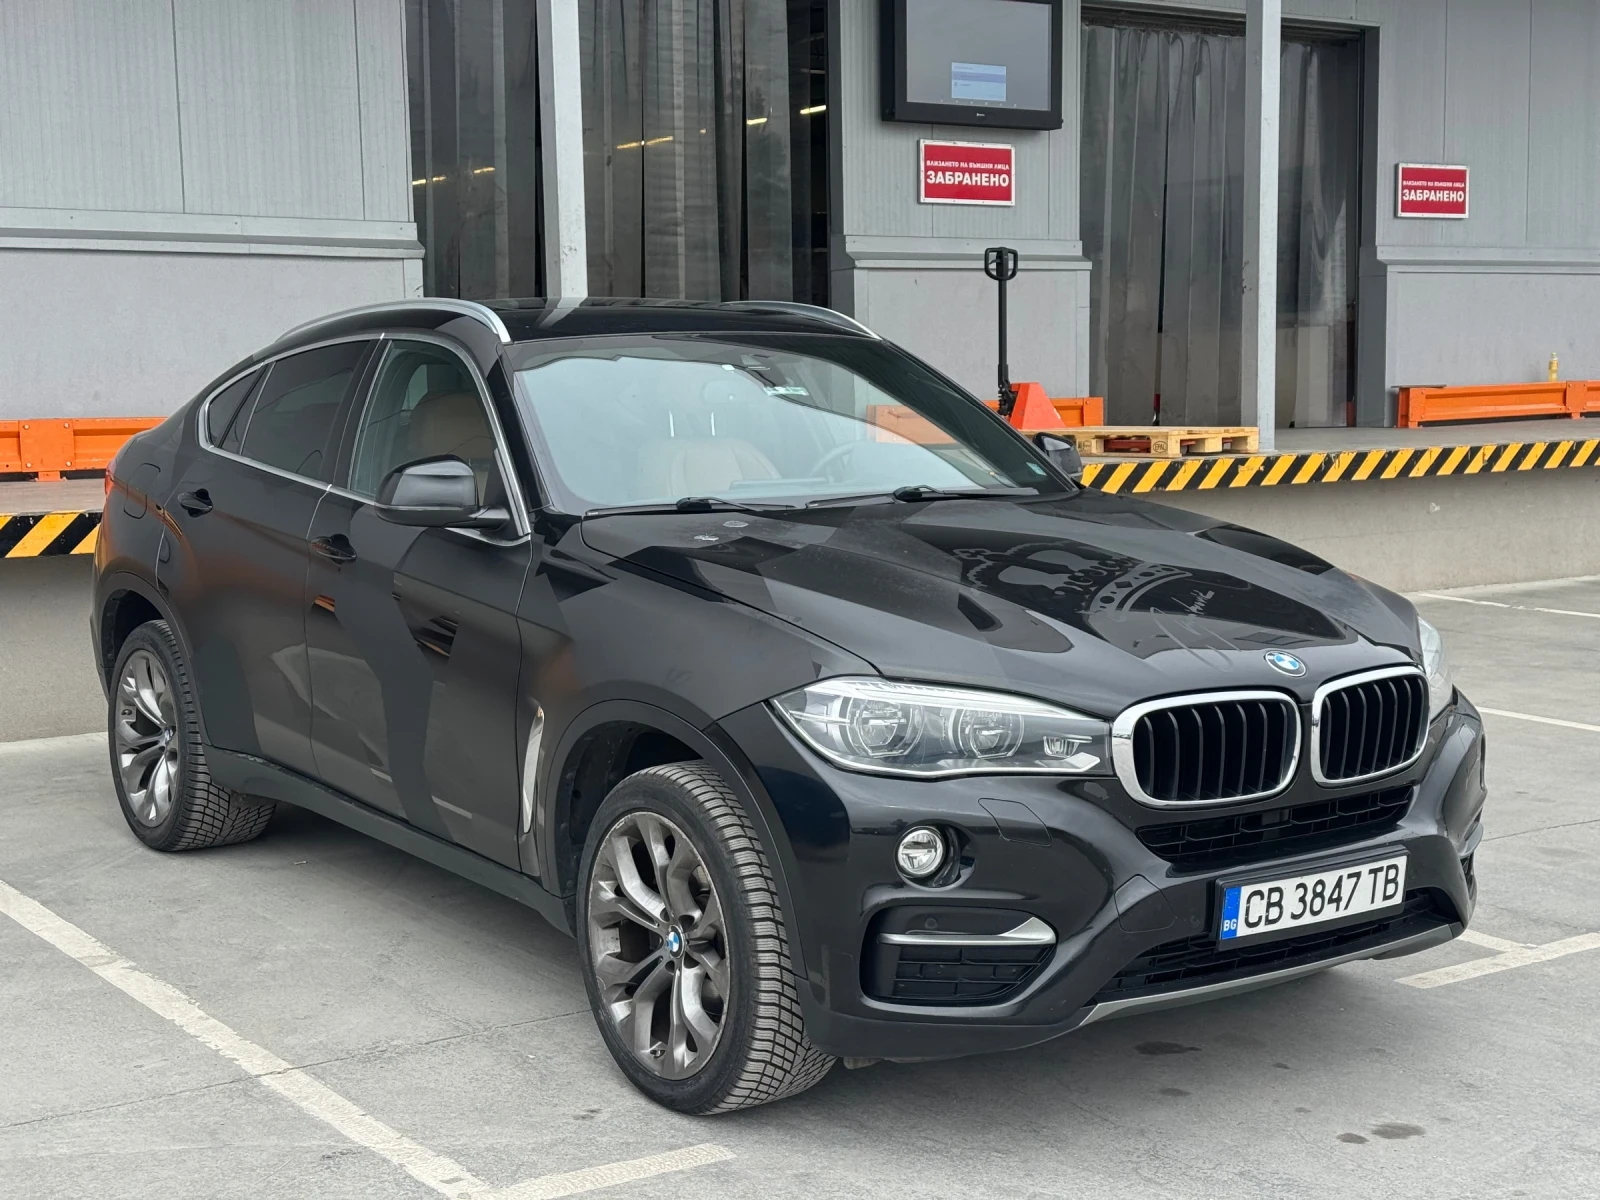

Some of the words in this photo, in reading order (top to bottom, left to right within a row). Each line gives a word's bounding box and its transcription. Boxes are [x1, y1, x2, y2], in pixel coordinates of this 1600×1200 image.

[926, 170, 1009, 187] ЗАБРАНЕНО
[1402, 189, 1464, 202] ЗАБРАНЕНО
[1244, 886, 1284, 928] CB
[1290, 870, 1362, 921] 3847
[1368, 863, 1400, 904] TB
[1223, 918, 1237, 932] BG
